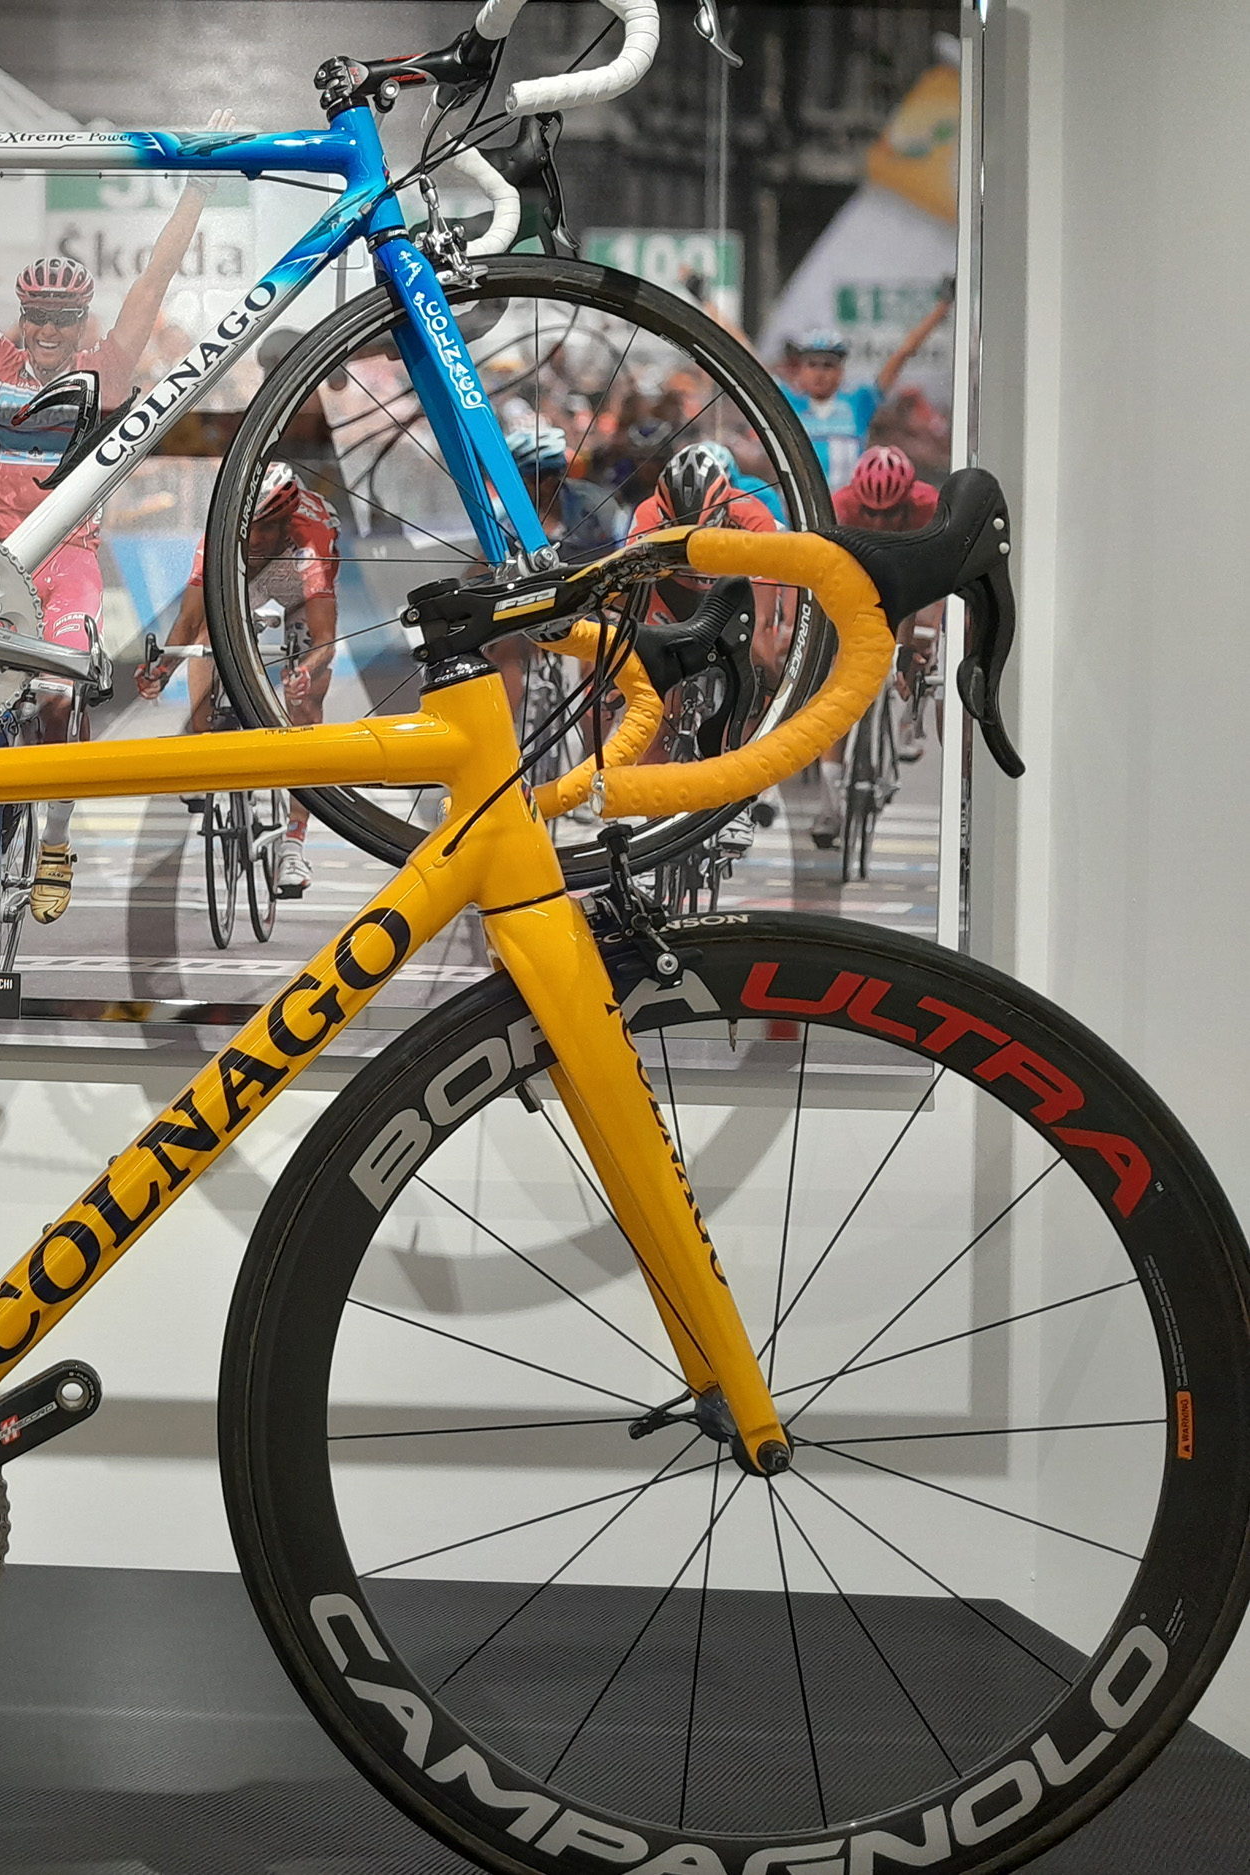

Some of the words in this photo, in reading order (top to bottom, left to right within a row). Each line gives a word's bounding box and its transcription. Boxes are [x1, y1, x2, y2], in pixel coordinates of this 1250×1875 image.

[89, 132, 135, 143] Power
[95, 281, 277, 467] COLNAGO
[426, 300, 483, 407] COLNAGO
[788, 603, 812, 680] DURA-ACE
[740, 962, 1153, 1220] ULTRA
[1180, 1398, 1191, 1443] WARNING
[310, 1593, 1169, 1875] CAMPAGNOLO
